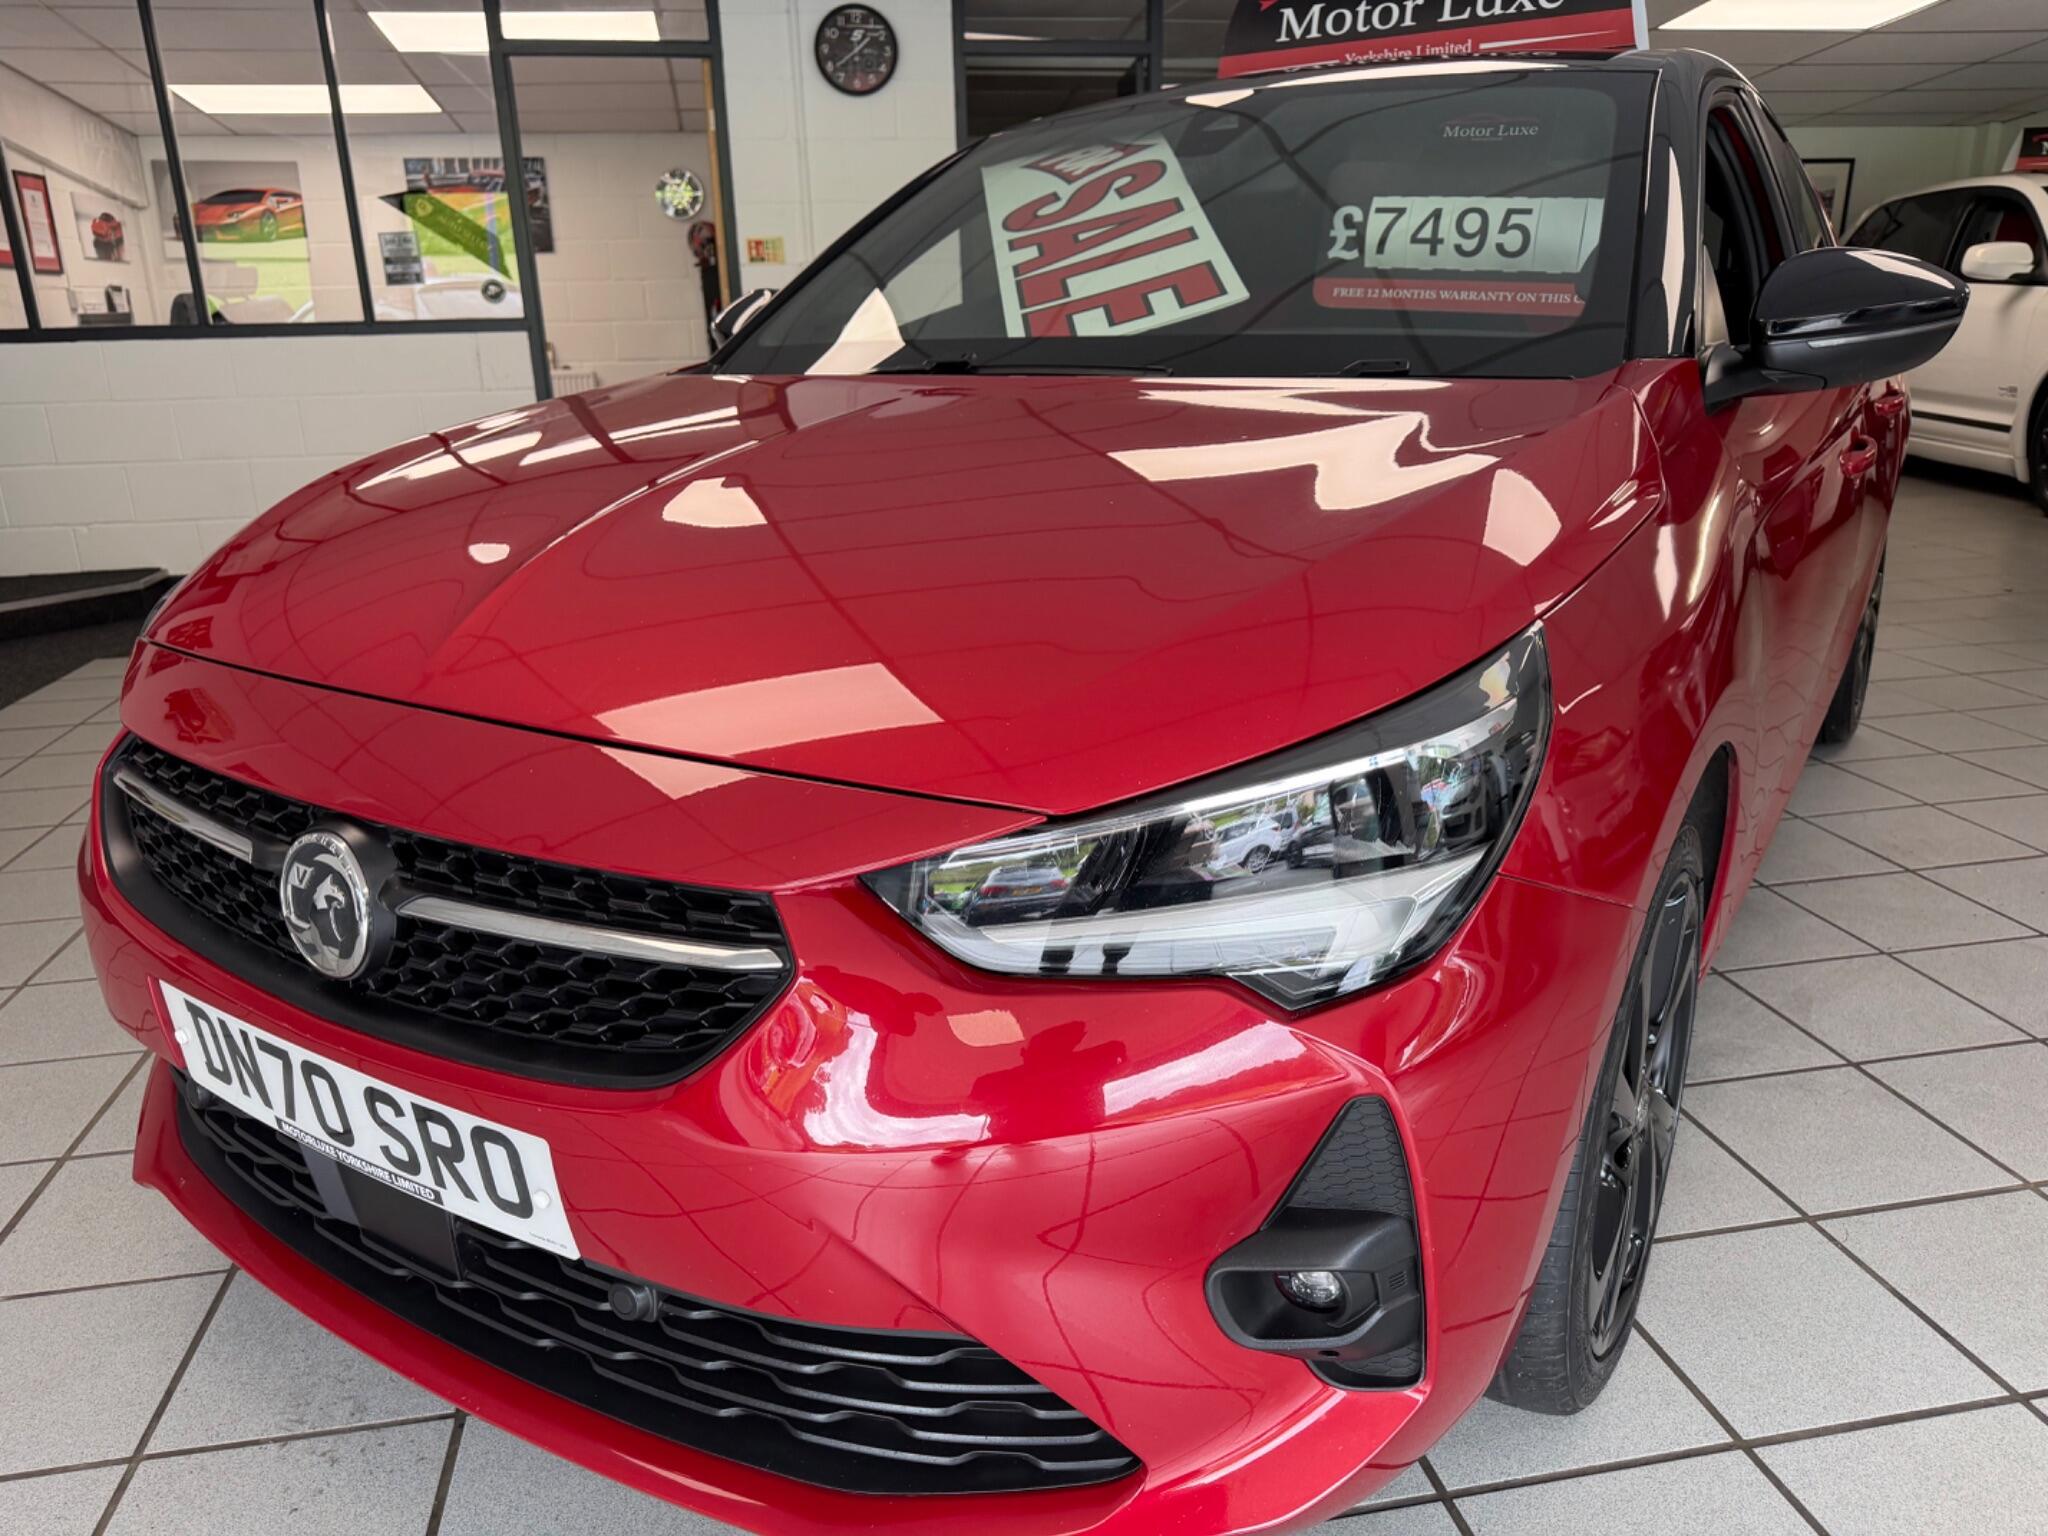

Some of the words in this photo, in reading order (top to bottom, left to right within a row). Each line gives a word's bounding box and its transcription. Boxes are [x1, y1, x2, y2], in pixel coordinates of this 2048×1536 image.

[1275, 0, 1425, 42] Motor
[1416, 39, 1472, 56] Limited
[1443, 125, 1495, 138] Motor
[1497, 124, 1539, 136] Luxe
[1002, 159, 1228, 337] SALE
[1327, 205, 1534, 260] £7495
[1333, 287, 1364, 298] FREE
[1367, 288, 1379, 298] 12
[1382, 288, 1436, 299] MONTHS
[1439, 289, 1513, 301] WARRANTY
[1516, 292, 1537, 302] ON
[1540, 292, 1571, 303] THIS
[184, 998, 355, 1147] DN70
[364, 1086, 534, 1219] SRO
[337, 1151, 393, 1183] YORKSHIRE
[391, 1174, 436, 1201] LIMITED
